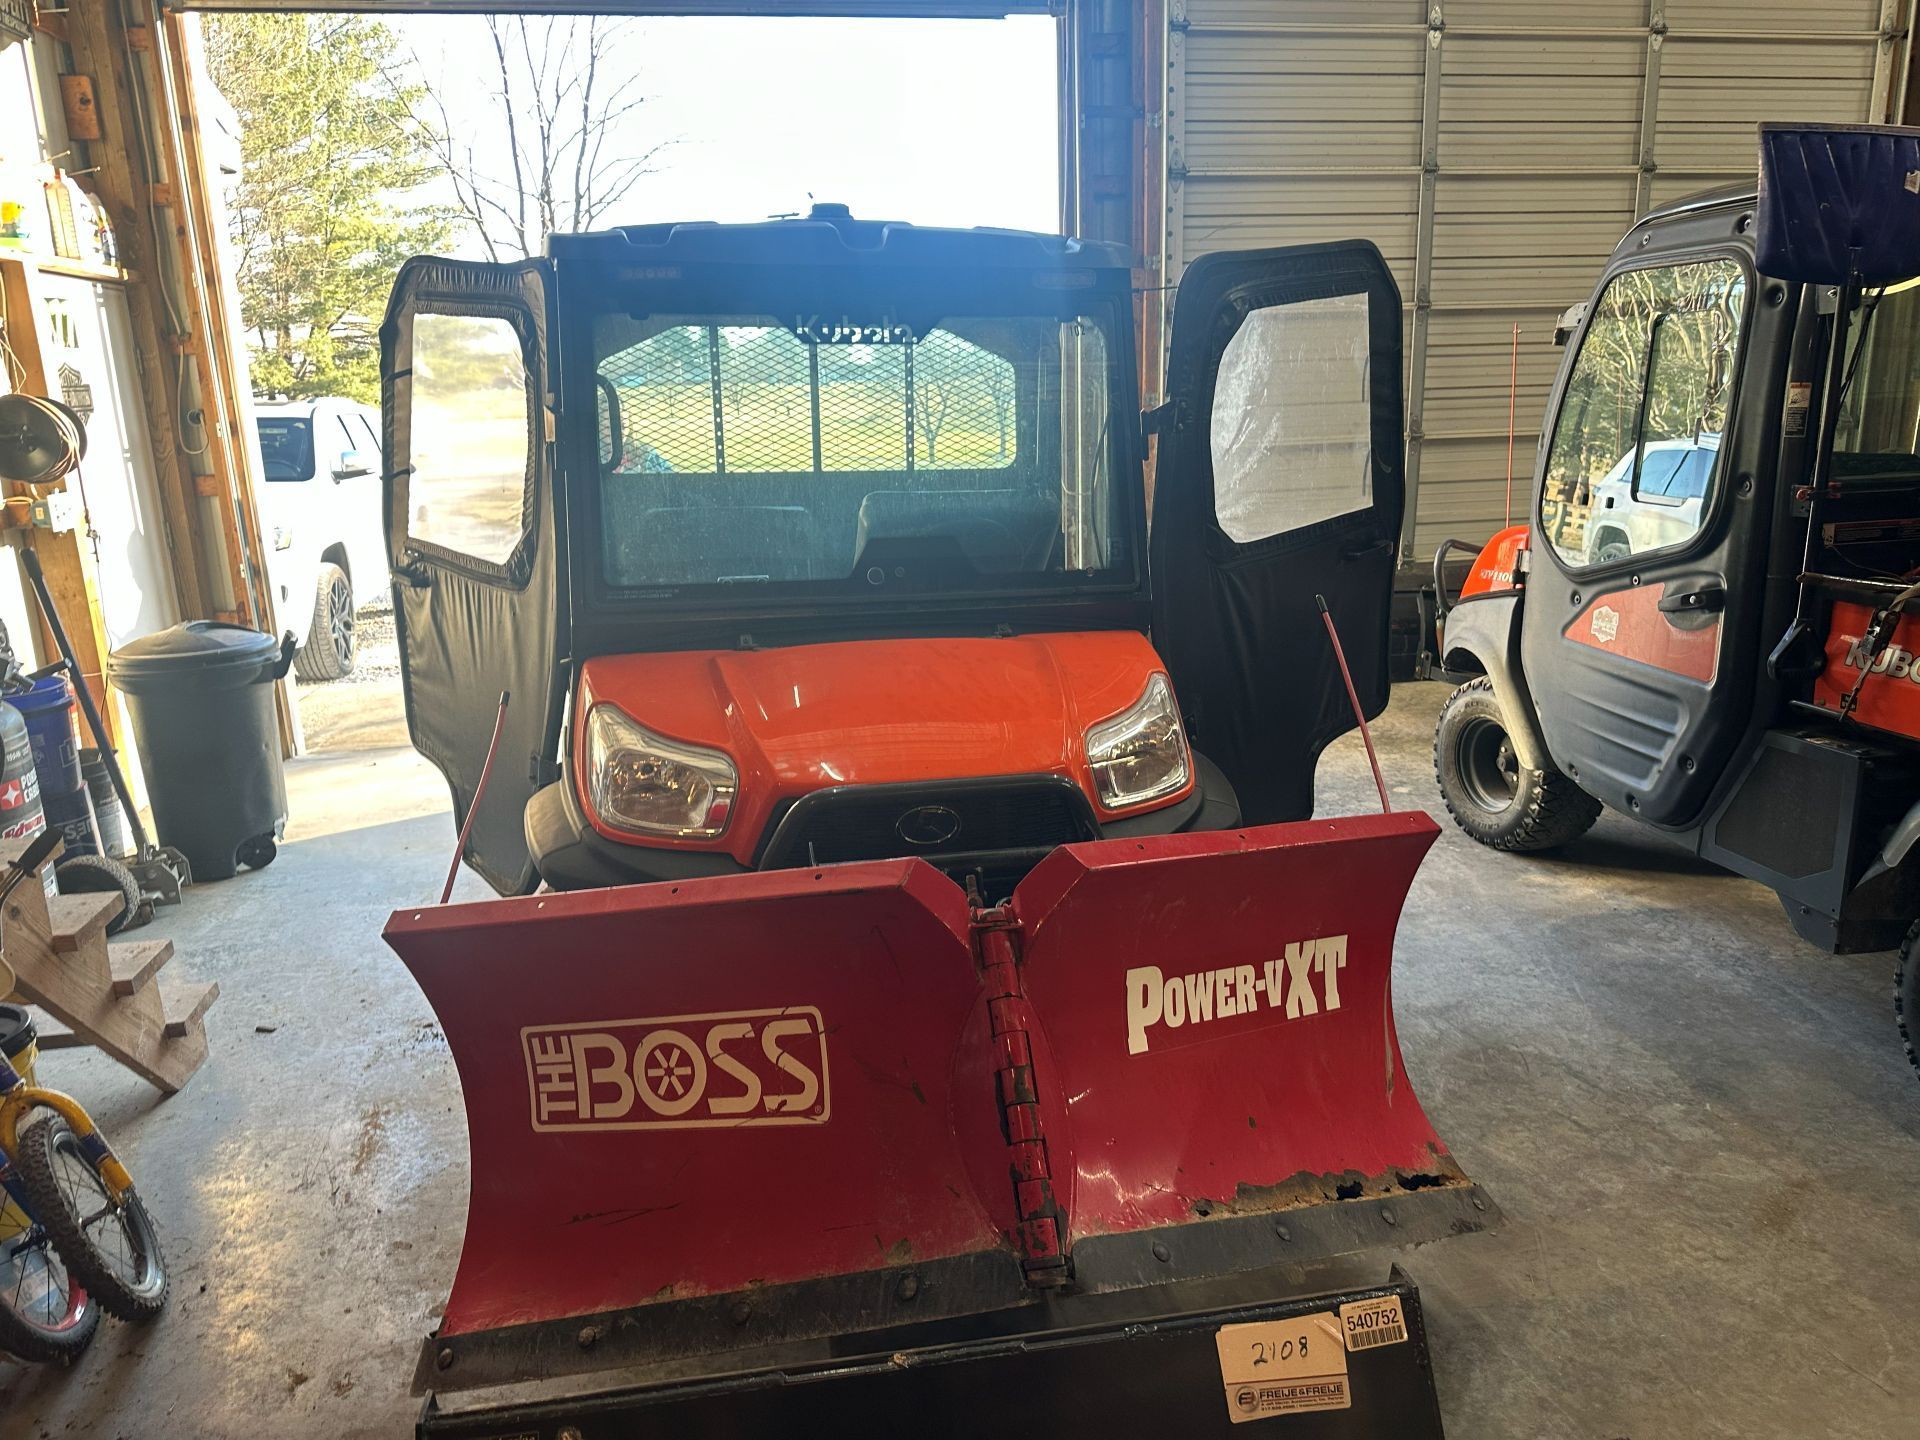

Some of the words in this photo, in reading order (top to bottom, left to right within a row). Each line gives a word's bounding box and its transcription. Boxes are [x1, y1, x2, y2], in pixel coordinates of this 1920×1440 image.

[796, 315, 912, 342] Kubota
[532, 1034, 577, 1121] THE
[571, 1019, 819, 1119] BOSS
[1347, 1308, 1399, 1331] 540752
[1252, 1336, 1308, 1367] 2108
